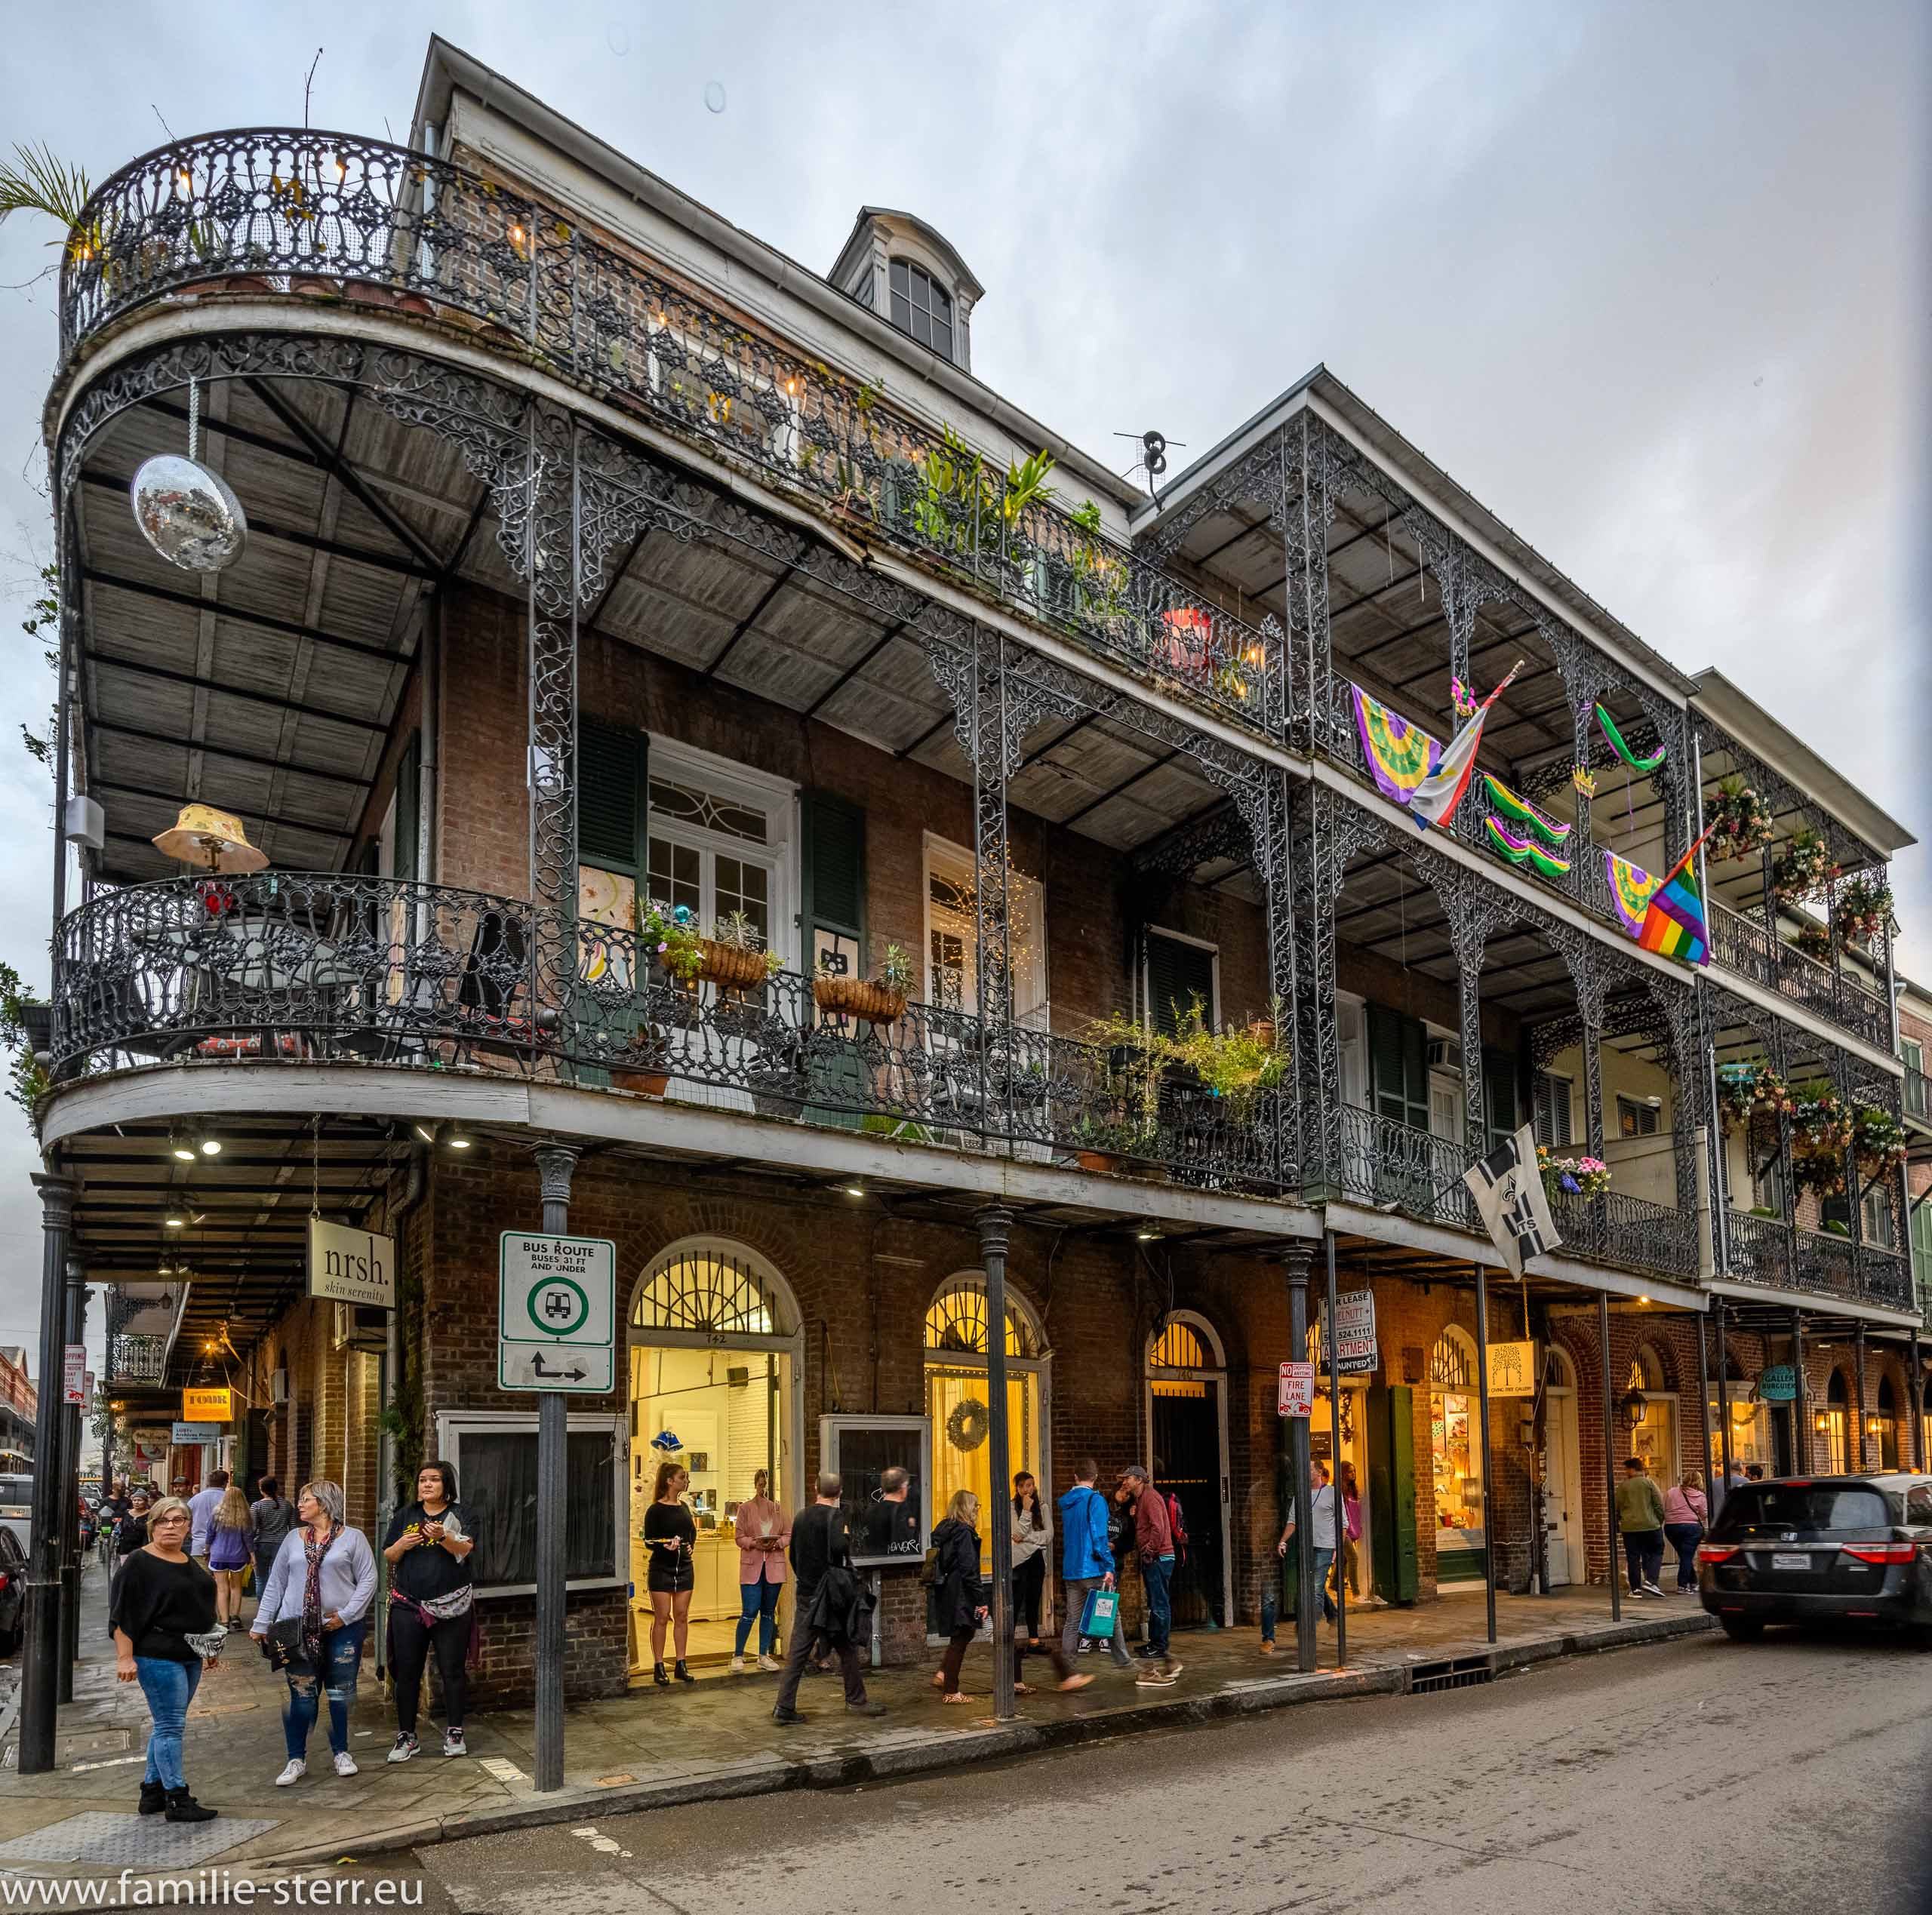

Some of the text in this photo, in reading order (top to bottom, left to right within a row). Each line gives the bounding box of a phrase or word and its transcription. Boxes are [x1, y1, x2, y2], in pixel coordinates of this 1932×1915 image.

[523, 1242, 595, 1258] BUS ROUTE
[325, 1236, 389, 1286] nrsh.
[531, 1254, 559, 1263] BUSES
[563, 1256, 573, 1265] 31
[531, 1262, 586, 1274] AND UNDER
[325, 1280, 385, 1305] skin serenity
[1324, 1293, 1369, 1309] FR LEASE
[1337, 1308, 1364, 1323] ELNUTT
[706, 1333, 727, 1344] 742
[1324, 1327, 1371, 1342] 5.524.1111
[1324, 1339, 1374, 1360] ARTMENT
[1281, 1365, 1292, 1376] NO
[1333, 1360, 1367, 1372] AUNTED
[1287, 1380, 1305, 1389] FIRE
[1286, 1391, 1306, 1401] LANE
